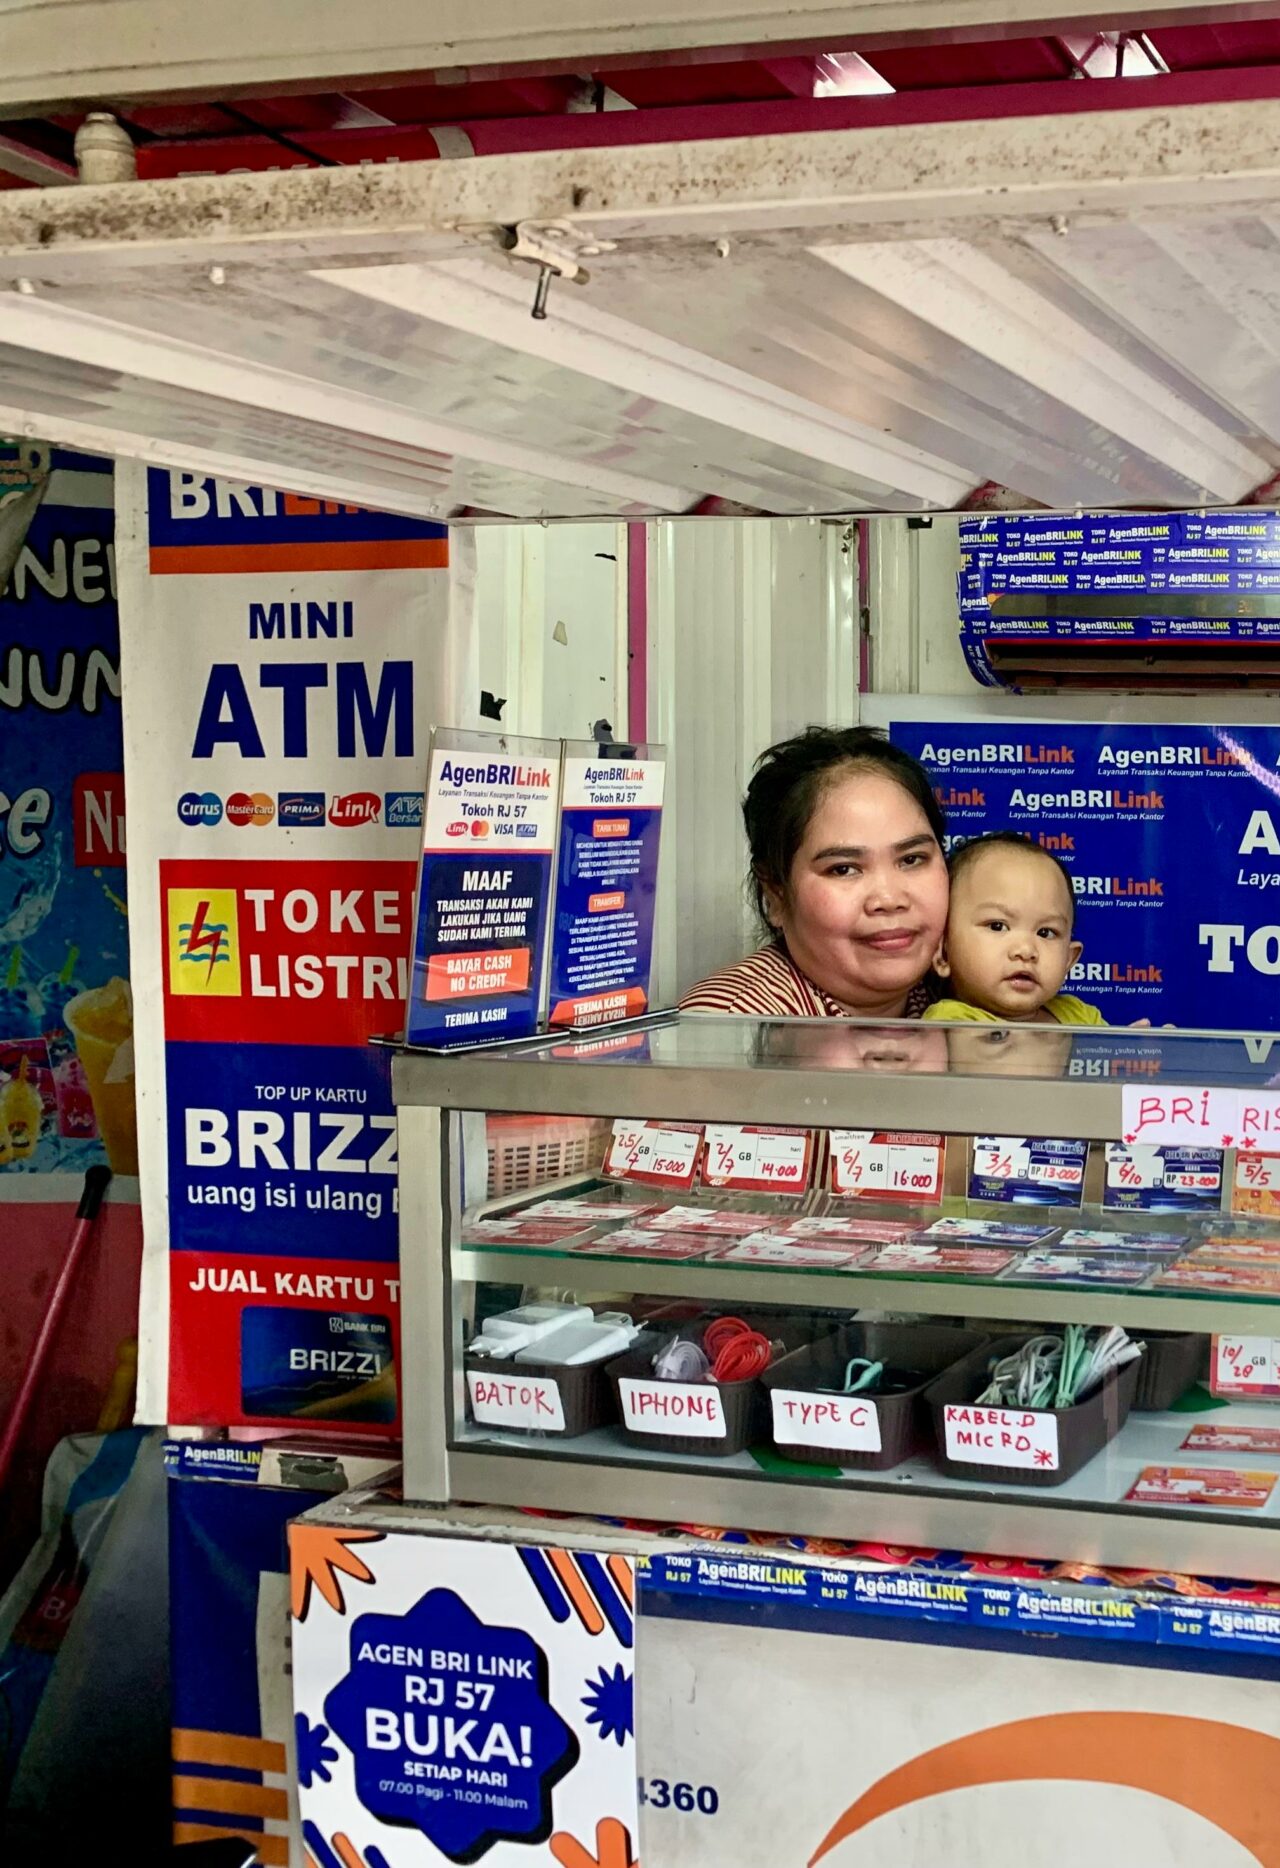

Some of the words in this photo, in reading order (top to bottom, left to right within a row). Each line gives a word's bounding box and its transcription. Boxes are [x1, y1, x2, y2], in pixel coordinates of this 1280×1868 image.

[1024, 530, 1083, 542] AgenBRILINK
[997, 551, 1056, 562] AgenBRILINK
[1009, 574, 1069, 585] AgenBRILINK
[250, 601, 353, 639] MINI
[990, 621, 1048, 632] AgenBRILINK
[192, 661, 414, 758] ATM
[920, 744, 1075, 766] AgenBRILink
[1098, 746, 1252, 768] AgenBRILink
[440, 761, 551, 787] AgenBRILink
[585, 767, 644, 783] AgenBRILink
[1098, 768, 1128, 777] Layanan
[1167, 769, 1203, 778] Keuangan
[1205, 770, 1229, 778] Tanpa
[590, 792, 614, 803] Tokoh
[616, 793, 625, 803] RJ
[627, 793, 636, 803] 57
[1009, 789, 1164, 811] AgenBRILink
[181, 801, 220, 815] Cirrus
[227, 804, 275, 816] MasterCard
[284, 804, 320, 813] PRIMA
[331, 795, 380, 824] Link
[461, 803, 494, 817] Tokoh
[497, 805, 511, 817] RJ
[514, 805, 527, 818] 57
[1009, 811, 1039, 820] Layanan
[1041, 811, 1077, 819] Transaksi
[1078, 812, 1114, 821] Keuangan
[1116, 813, 1138, 821] Tanpa
[447, 822, 467, 834] Link
[494, 824, 514, 835] VISA
[462, 871, 513, 891] MAAF
[245, 889, 416, 933] TOKE
[437, 899, 484, 912] TRANSAKSI
[486, 898, 509, 910] AKAN
[511, 897, 533, 909] KAMI
[441, 914, 480, 927] LAKUKAN
[482, 912, 501, 925] JIKA
[504, 911, 526, 924] UANG
[438, 928, 468, 942] SUDAH
[470, 927, 492, 940] KAMI
[494, 925, 526, 938] TERIMA
[447, 958, 481, 974] BAYAR
[484, 955, 512, 970] CASH
[451, 977, 465, 992] NO
[469, 973, 507, 990] CREDIT
[574, 1000, 603, 1015] TERIMA
[604, 995, 627, 1010] KASIH
[445, 1013, 479, 1028] TERIMA
[481, 1008, 508, 1022] KASIH
[255, 1085, 285, 1100] TOP
[290, 1086, 311, 1101] UP
[316, 1088, 367, 1103] KARTU
[185, 1108, 398, 1175] BRIZZ
[738, 1152, 752, 1161] GB
[869, 1163, 883, 1172] GB
[188, 1184, 256, 1212] uang
[265, 1182, 296, 1207] isi
[306, 1185, 382, 1219] ulang
[189, 1268, 267, 1294] JUAL
[275, 1272, 374, 1301] KARTU
[344, 1322, 368, 1332] BANK
[370, 1323, 386, 1333] BRI
[289, 1349, 382, 1375] BRIZZI
[475, 1381, 554, 1415] BATOK
[631, 1391, 716, 1421] IPHONE
[783, 1401, 842, 1425] TYPE
[851, 1407, 869, 1426] C
[957, 1431, 1031, 1451] MICRO
[665, 1556, 692, 1568] TOKO
[698, 1558, 807, 1585] AgenBRILINK
[666, 1571, 677, 1581] RJ
[680, 1572, 691, 1582] 57
[821, 1570, 848, 1584] TOKO
[821, 1588, 834, 1598] RJ
[836, 1589, 848, 1599] 57
[854, 1576, 968, 1602] AgenBRILINK
[1017, 1592, 1135, 1618] AgenBRILINK
[358, 1642, 424, 1667] AGEN
[431, 1650, 470, 1672] BRI
[477, 1655, 533, 1680] LINK
[405, 1675, 444, 1706] RJ
[455, 1682, 495, 1712] 57
[365, 1708, 533, 1768] BUKA!
[404, 1761, 462, 1781] SETIAP
[466, 1769, 508, 1788] HARI
[379, 1780, 413, 1795] 07.00
[416, 1785, 444, 1801] Pagi
[454, 1789, 481, 1803] 11.00
[485, 1793, 528, 1810] Malam
